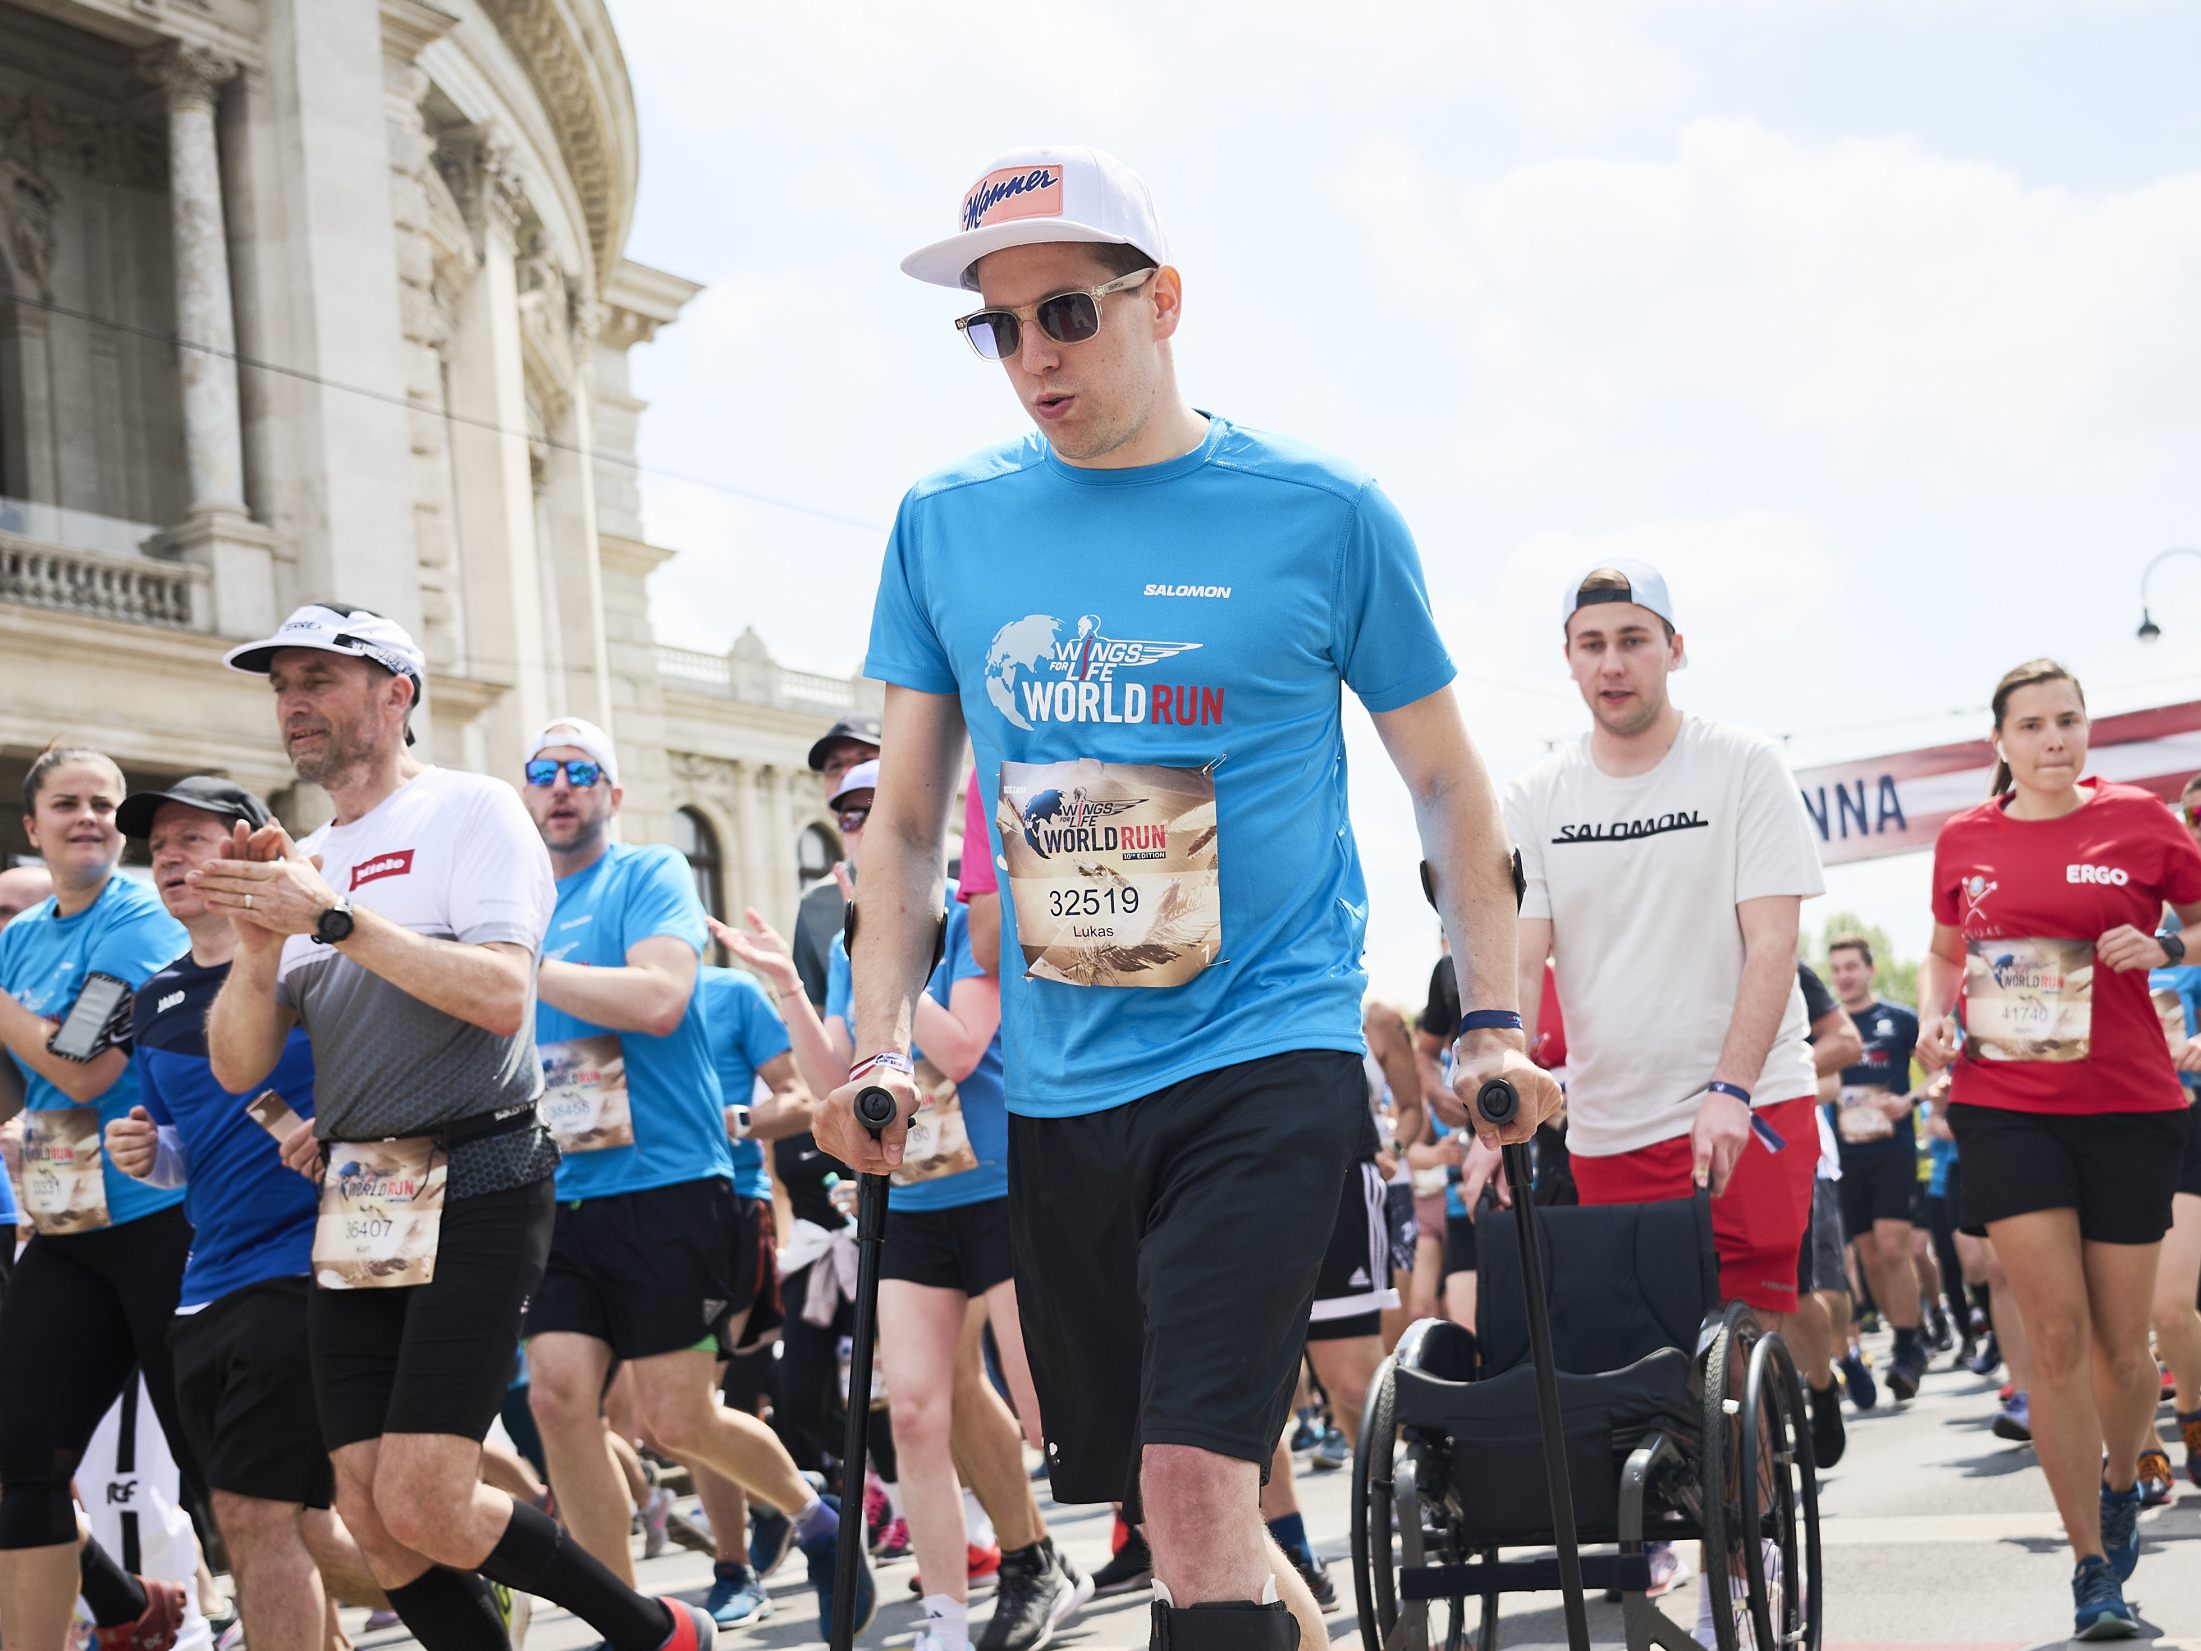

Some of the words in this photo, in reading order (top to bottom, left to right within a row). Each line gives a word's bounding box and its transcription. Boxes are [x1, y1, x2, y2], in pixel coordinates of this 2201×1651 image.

[963, 169, 1059, 231] Manner
[1143, 584, 1232, 599] SALOMON
[1049, 661, 1069, 671] FOR
[1066, 660, 1118, 682] LIFE
[1022, 681, 1147, 724] WORLD
[1151, 684, 1225, 726] RUN
[1068, 815, 1099, 828] LIFE
[1553, 810, 1708, 844] SALOMON
[1044, 826, 1118, 854] WORLD
[1120, 824, 1166, 850] RUN
[1137, 851, 1165, 859] EDITION
[2066, 864, 2128, 886] ERGO
[1049, 886, 1139, 917] 32519
[1073, 926, 1114, 938] Lukas
[2003, 975, 2040, 989] WORLD
[2040, 975, 2065, 989] RUN
[2001, 1007, 2049, 1022] 41740
[349, 1182, 387, 1198] WORLD
[387, 1180, 415, 1196] RUN
